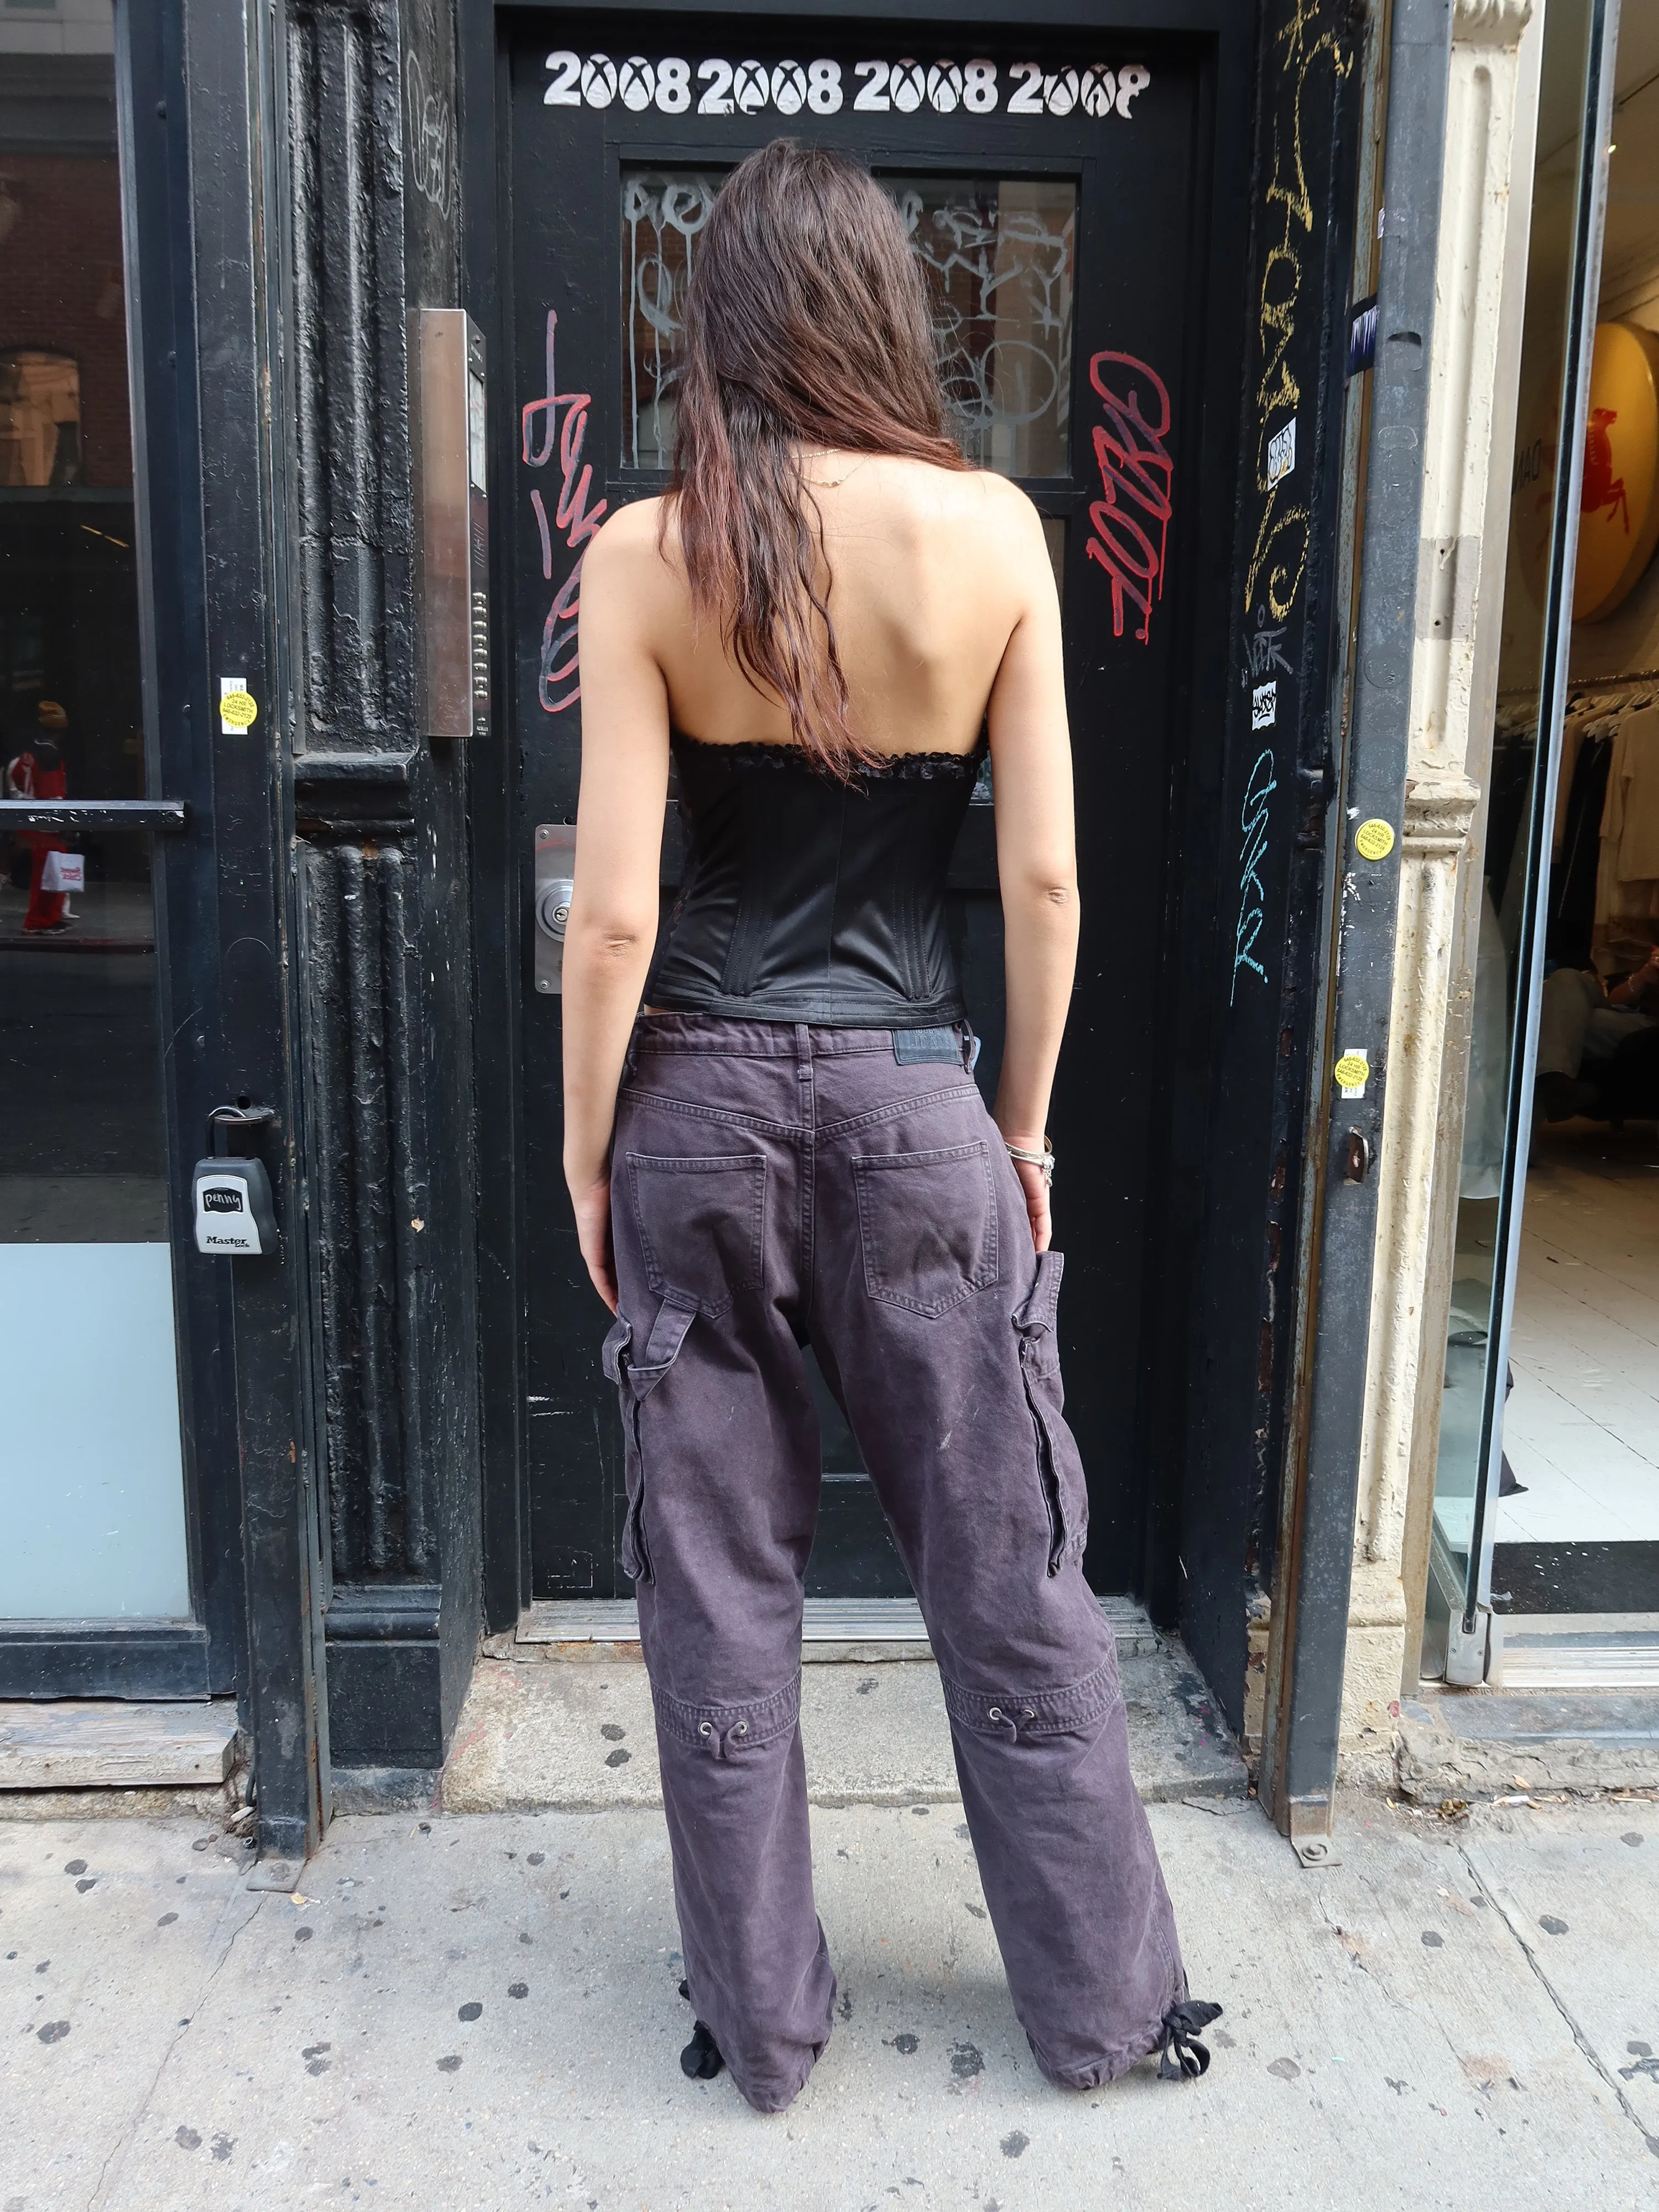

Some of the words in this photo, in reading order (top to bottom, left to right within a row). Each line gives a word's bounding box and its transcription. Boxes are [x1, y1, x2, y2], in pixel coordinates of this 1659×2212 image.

[223, 702, 253, 713] LOCKSMITH
[223, 714, 251, 726] EMERGENCY
[1363, 829, 1388, 846] LOCKSMITH
[1359, 840, 1382, 855] EMERGENCY
[911, 1035, 951, 1049] JEANS
[1339, 1063, 1365, 1077] LOCKSMITH
[1336, 1074, 1360, 1087] EMERGENCY
[205, 1192, 241, 1211] penny
[206, 1236, 247, 1244] Master
